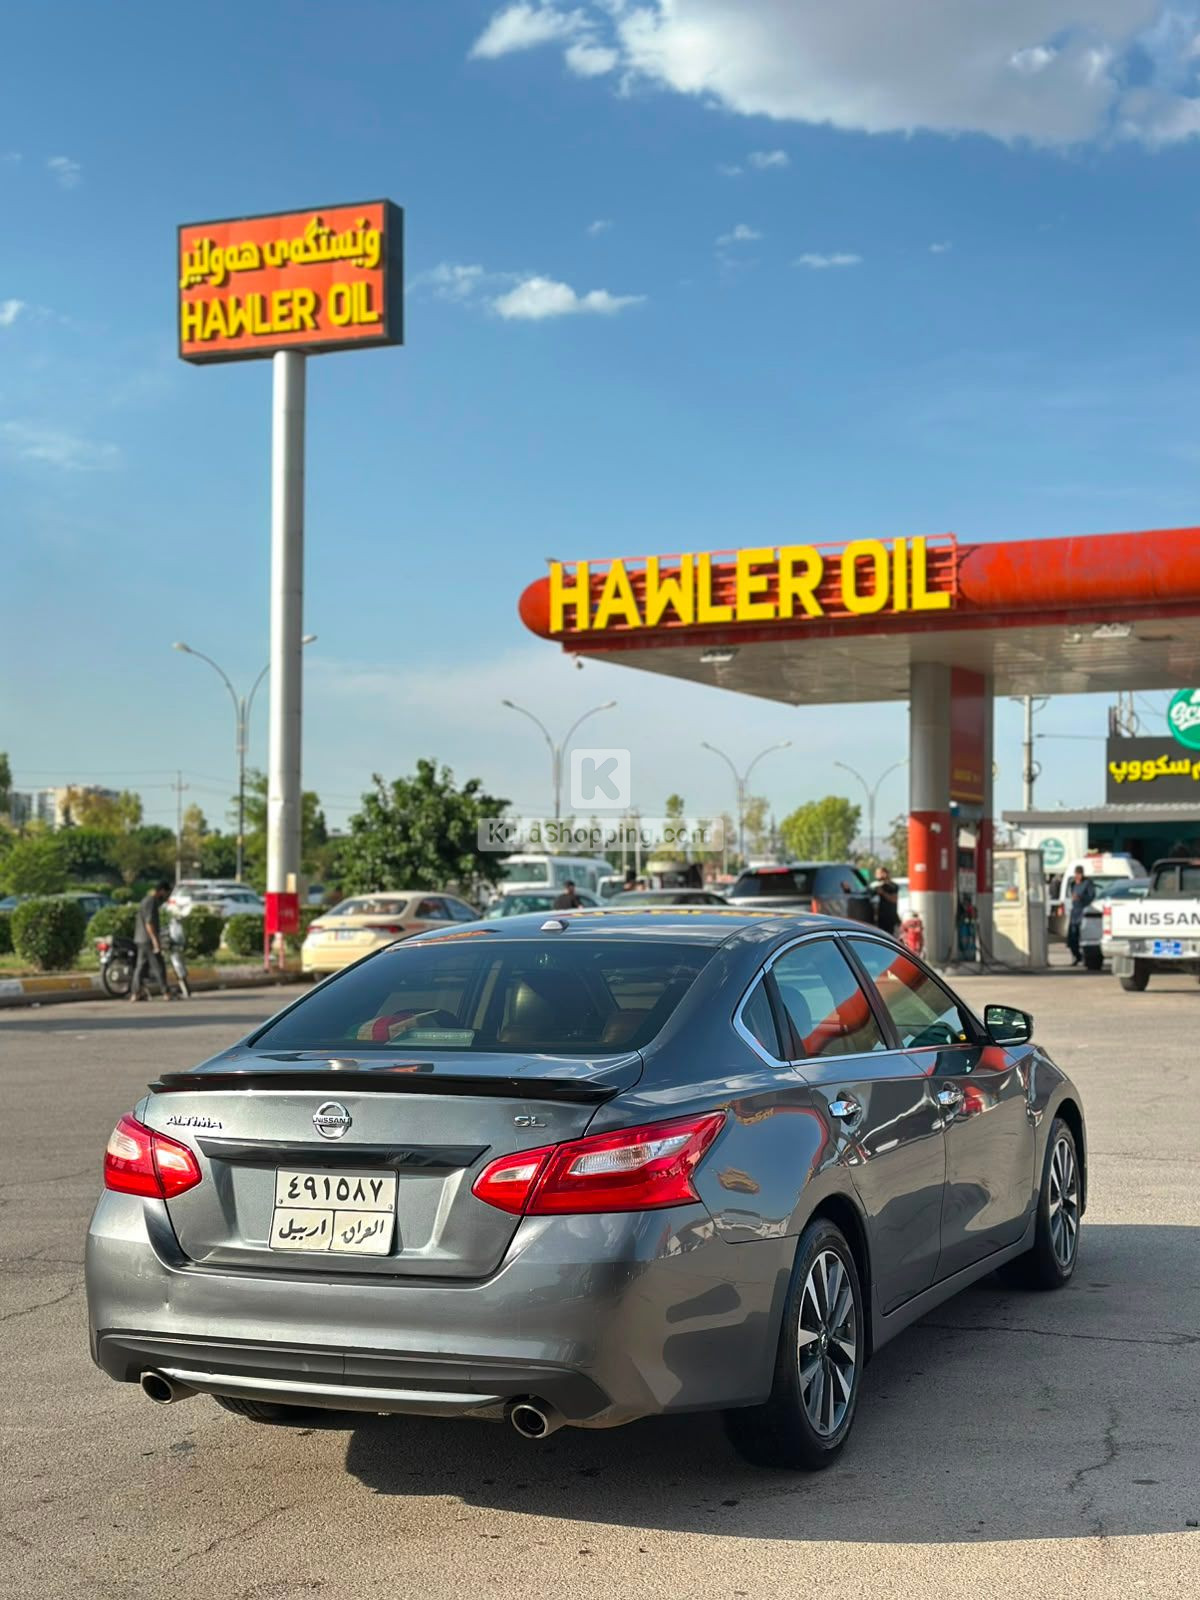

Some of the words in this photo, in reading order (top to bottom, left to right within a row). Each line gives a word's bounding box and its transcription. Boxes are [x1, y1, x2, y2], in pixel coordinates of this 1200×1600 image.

[182, 287, 316, 342] HAWLER
[328, 281, 379, 326] OIL
[549, 544, 825, 633] HAWLER
[841, 535, 951, 614] OIL
[1128, 911, 1200, 926] NISSAN
[166, 1115, 222, 1129] ALTIMA
[314, 1116, 347, 1124] NISSAN
[514, 1115, 546, 1127] SL
[287, 1175, 384, 1203] ٤٩١٥٨٧
[341, 1219, 385, 1245] العراق
